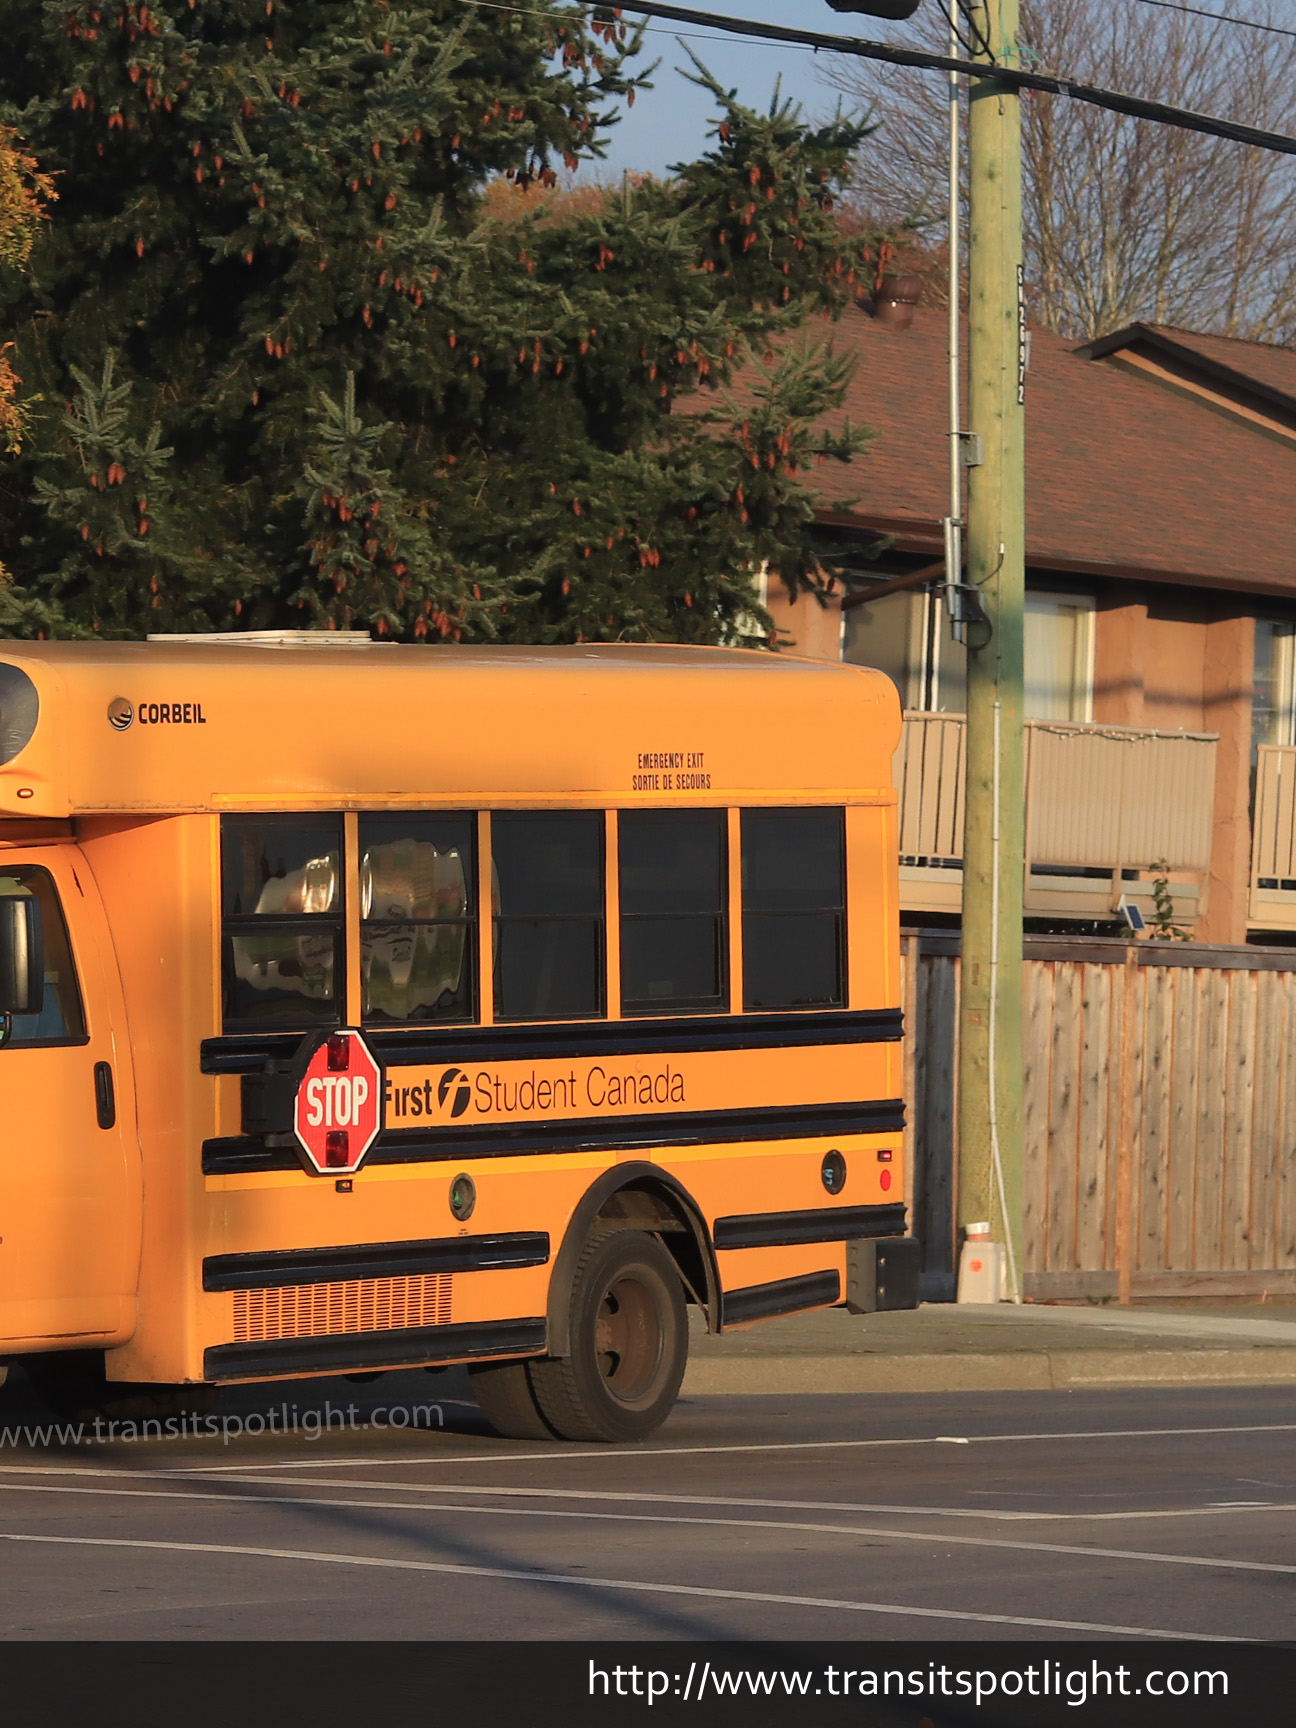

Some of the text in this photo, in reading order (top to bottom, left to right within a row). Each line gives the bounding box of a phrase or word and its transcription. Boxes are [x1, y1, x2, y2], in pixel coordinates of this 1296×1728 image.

[138, 703, 206, 724] CORBEIL
[638, 752, 704, 769] EMERGENCY EXIT
[632, 773, 711, 790] SORTIE DE SECOURS
[475, 1072, 577, 1114] Student
[586, 1064, 685, 1108] Canada
[306, 1076, 368, 1127] STOP
